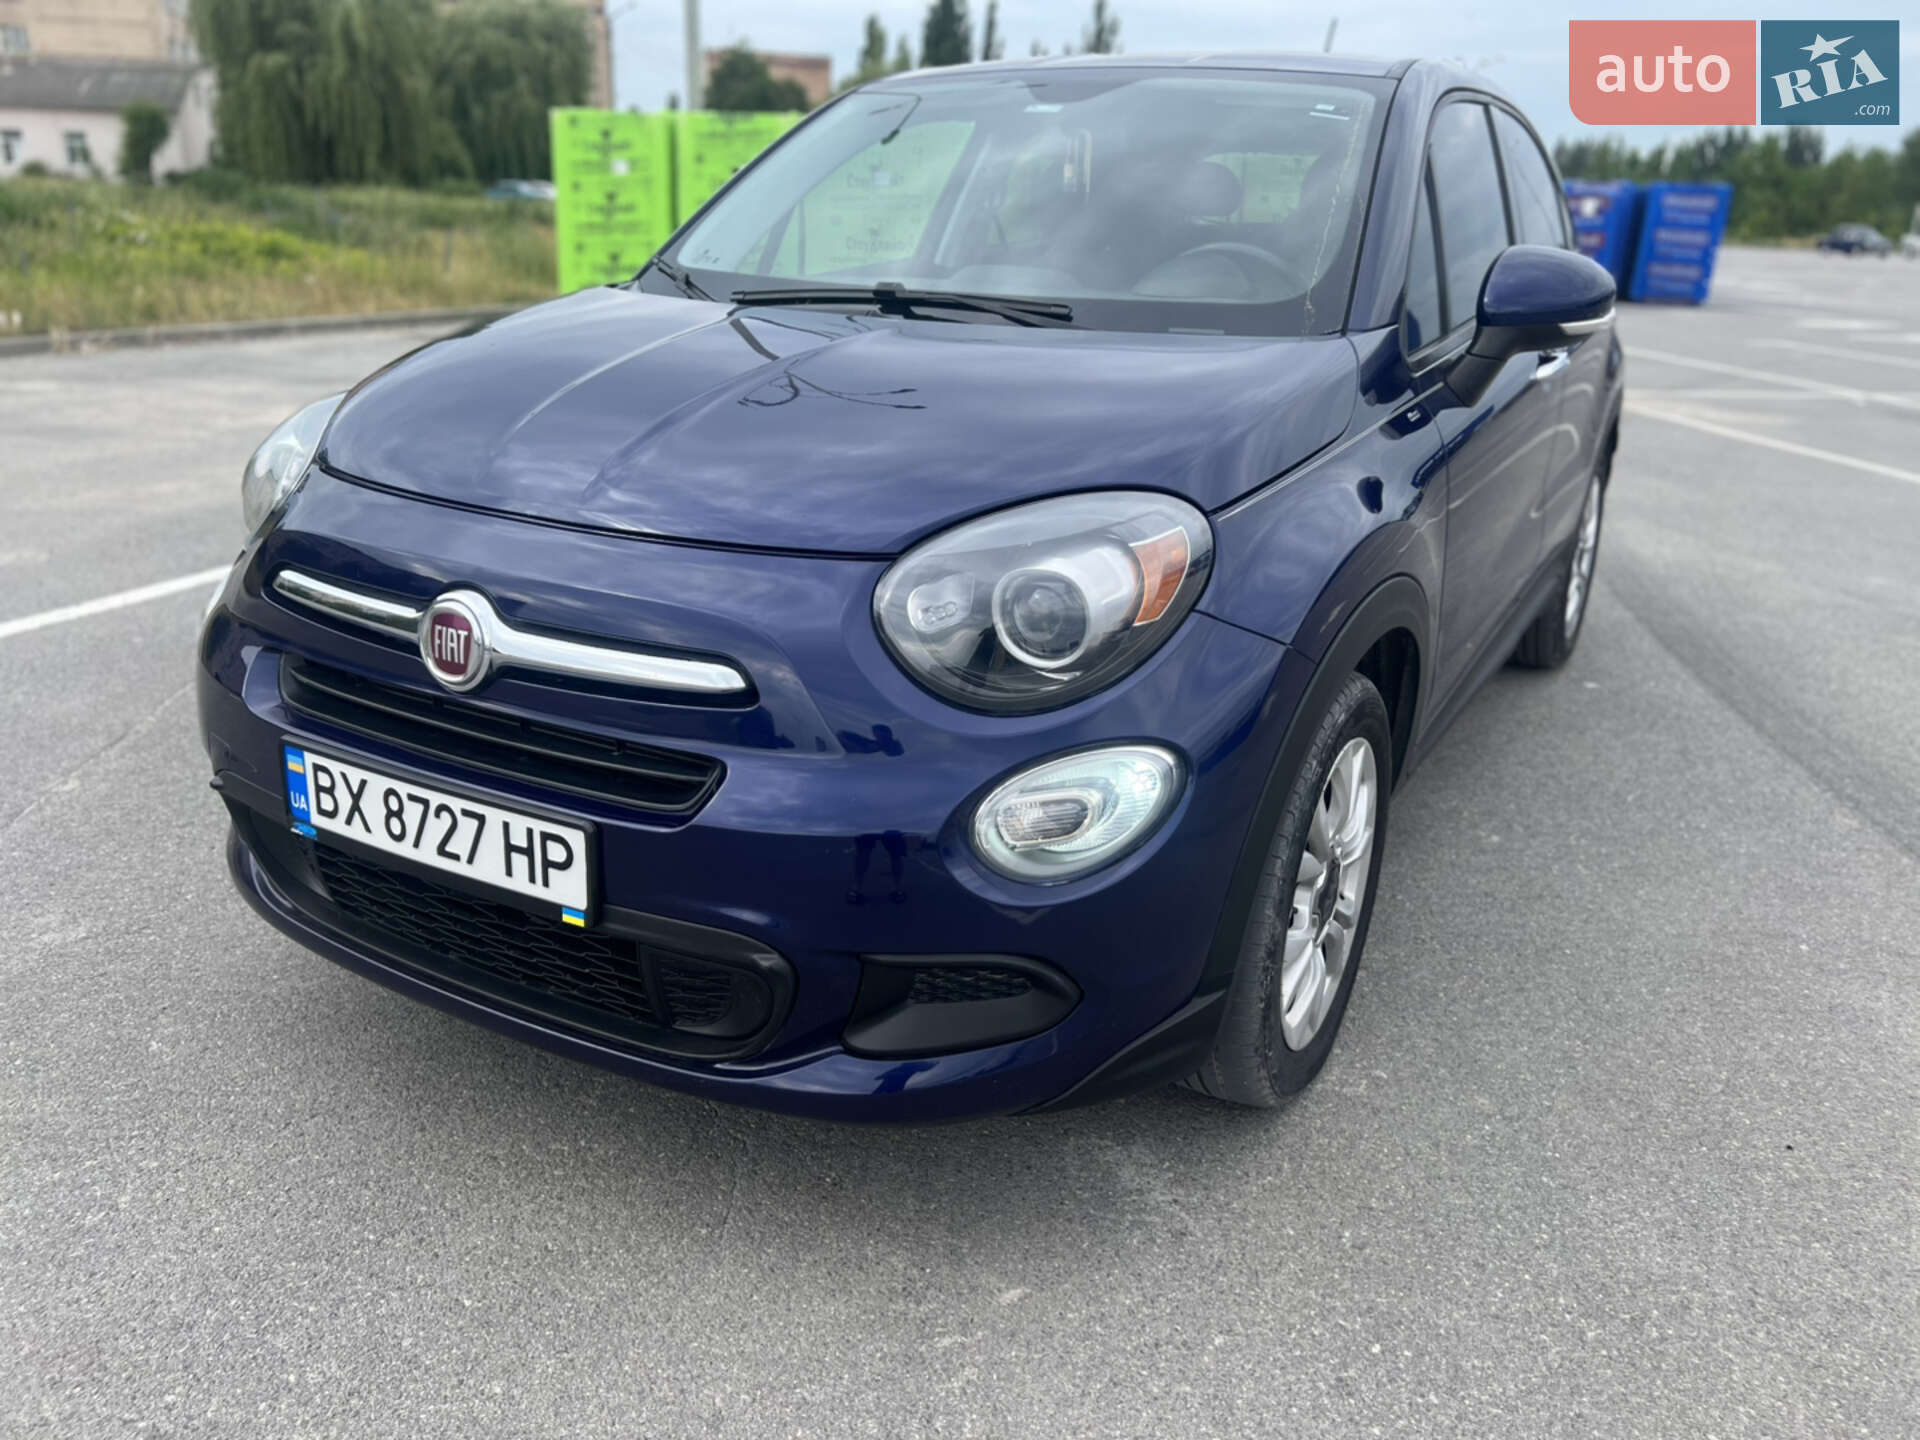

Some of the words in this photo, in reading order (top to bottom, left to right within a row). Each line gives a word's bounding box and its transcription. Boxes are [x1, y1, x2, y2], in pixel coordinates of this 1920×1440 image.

[434, 624, 469, 665] FIAT
[290, 790, 308, 813] UA
[312, 762, 372, 834] BX
[382, 787, 487, 866] 8727
[502, 820, 574, 888] HP
